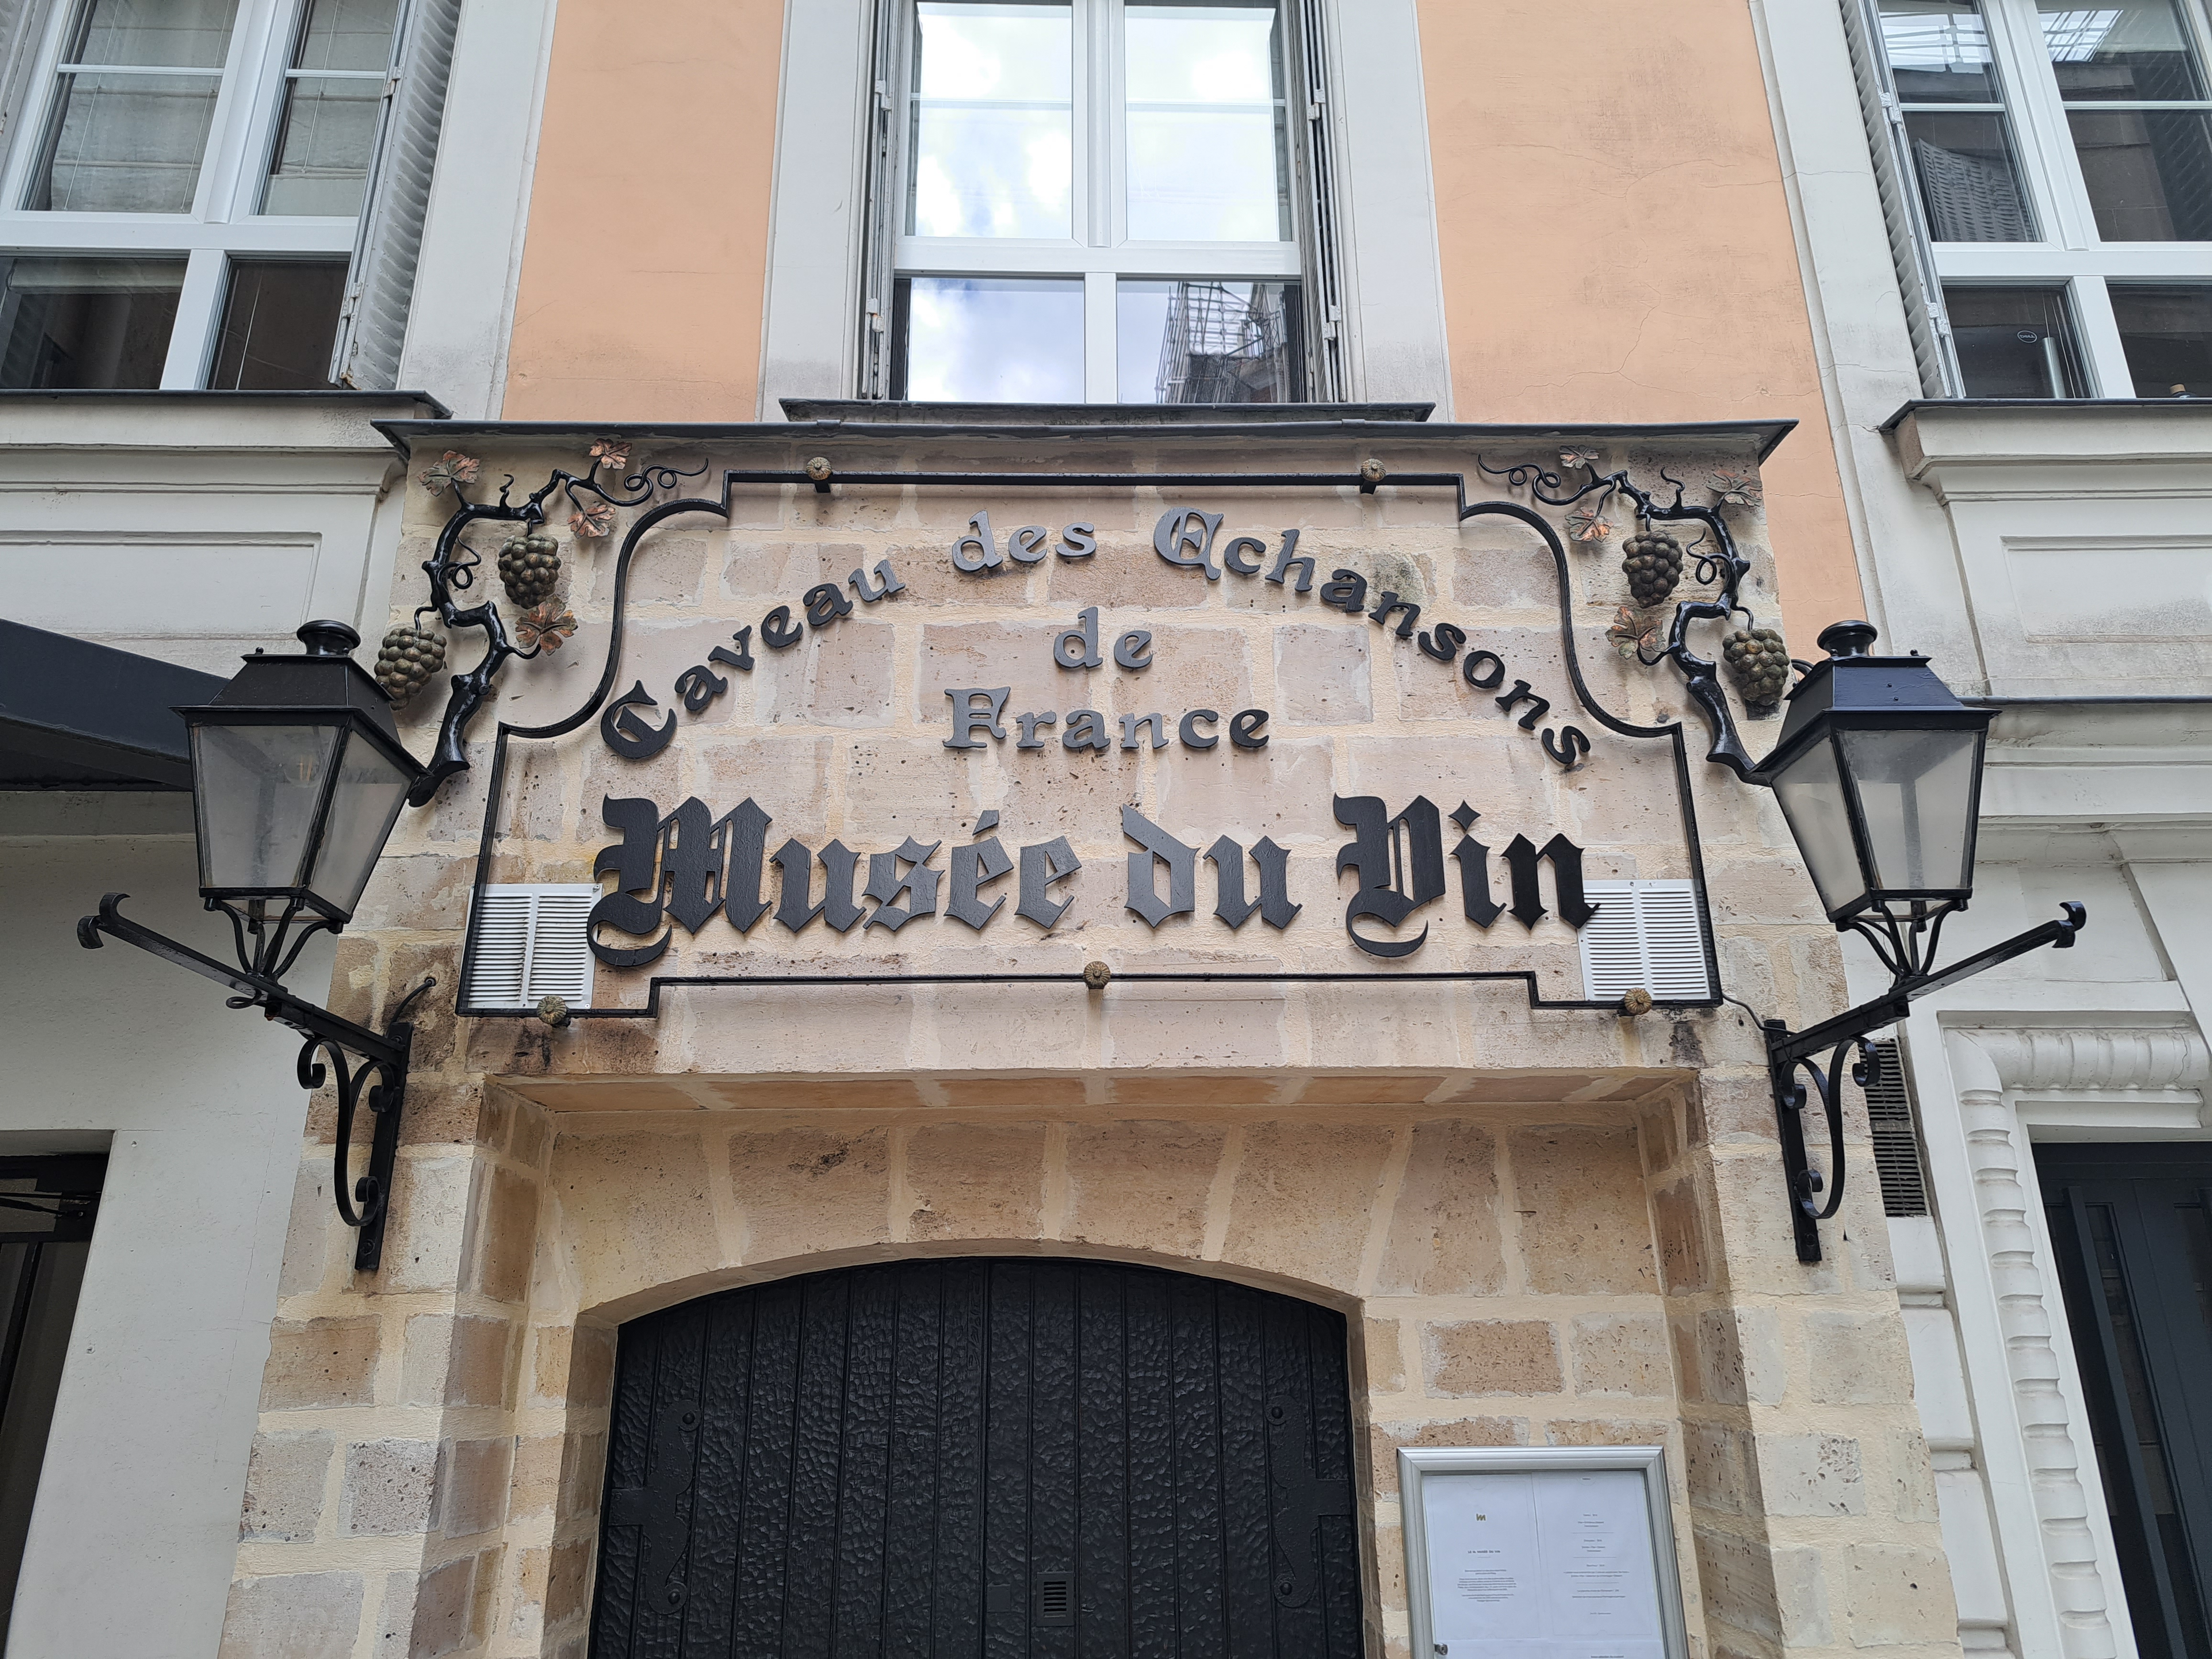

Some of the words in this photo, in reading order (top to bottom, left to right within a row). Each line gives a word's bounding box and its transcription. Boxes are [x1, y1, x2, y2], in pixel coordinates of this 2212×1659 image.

[600, 559, 906, 760] Caveau
[951, 509, 1097, 573] des
[1153, 506, 1591, 764] Echansons
[1053, 606, 1152, 669] de
[942, 686, 1270, 749] France
[586, 793, 1082, 967] Musée
[1120, 803, 1303, 929] du
[1333, 791, 1601, 957] Vin
